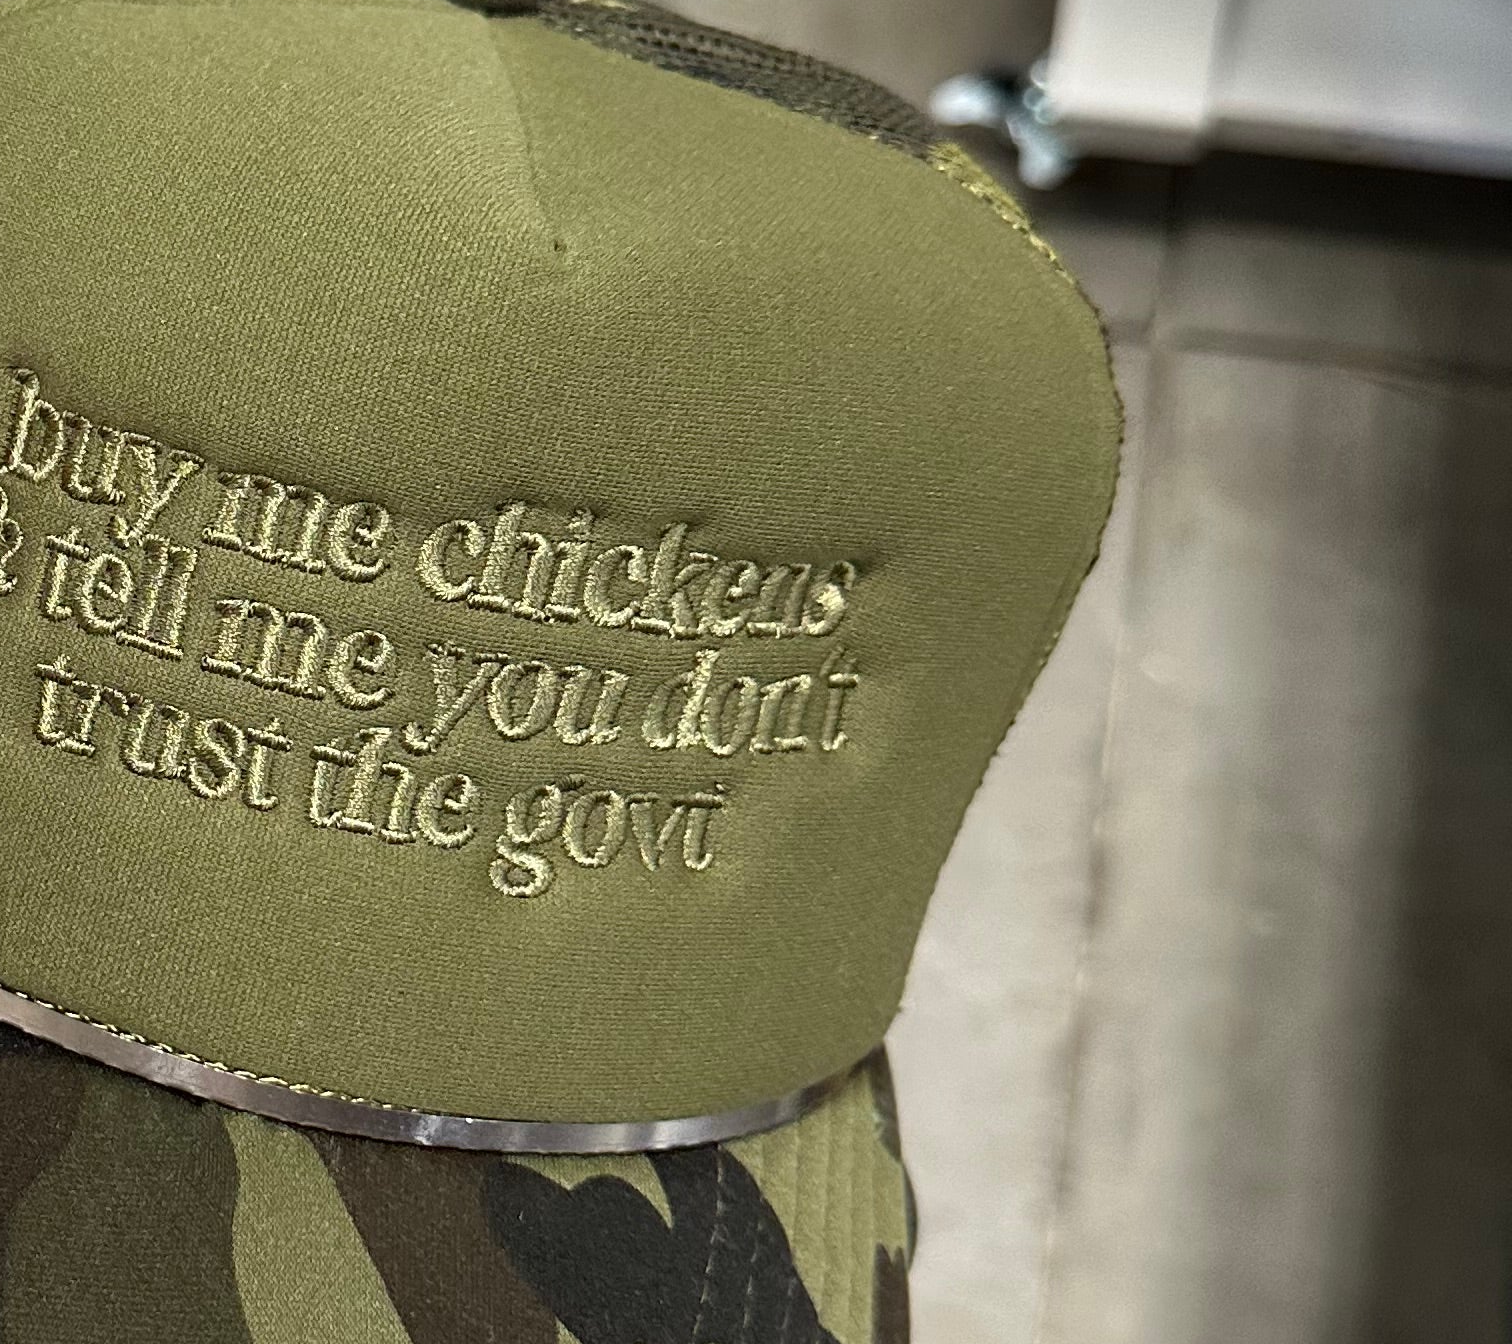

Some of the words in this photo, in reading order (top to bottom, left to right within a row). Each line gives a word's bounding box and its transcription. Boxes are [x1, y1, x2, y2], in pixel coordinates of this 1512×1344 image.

[0, 366, 205, 549] buy
[201, 471, 390, 582] me
[415, 501, 857, 640] chickens
[36, 655, 294, 810] trust
[309, 727, 478, 848] the
[42, 527, 198, 660] tell
[201, 598, 394, 711] me
[401, 643, 630, 754] you
